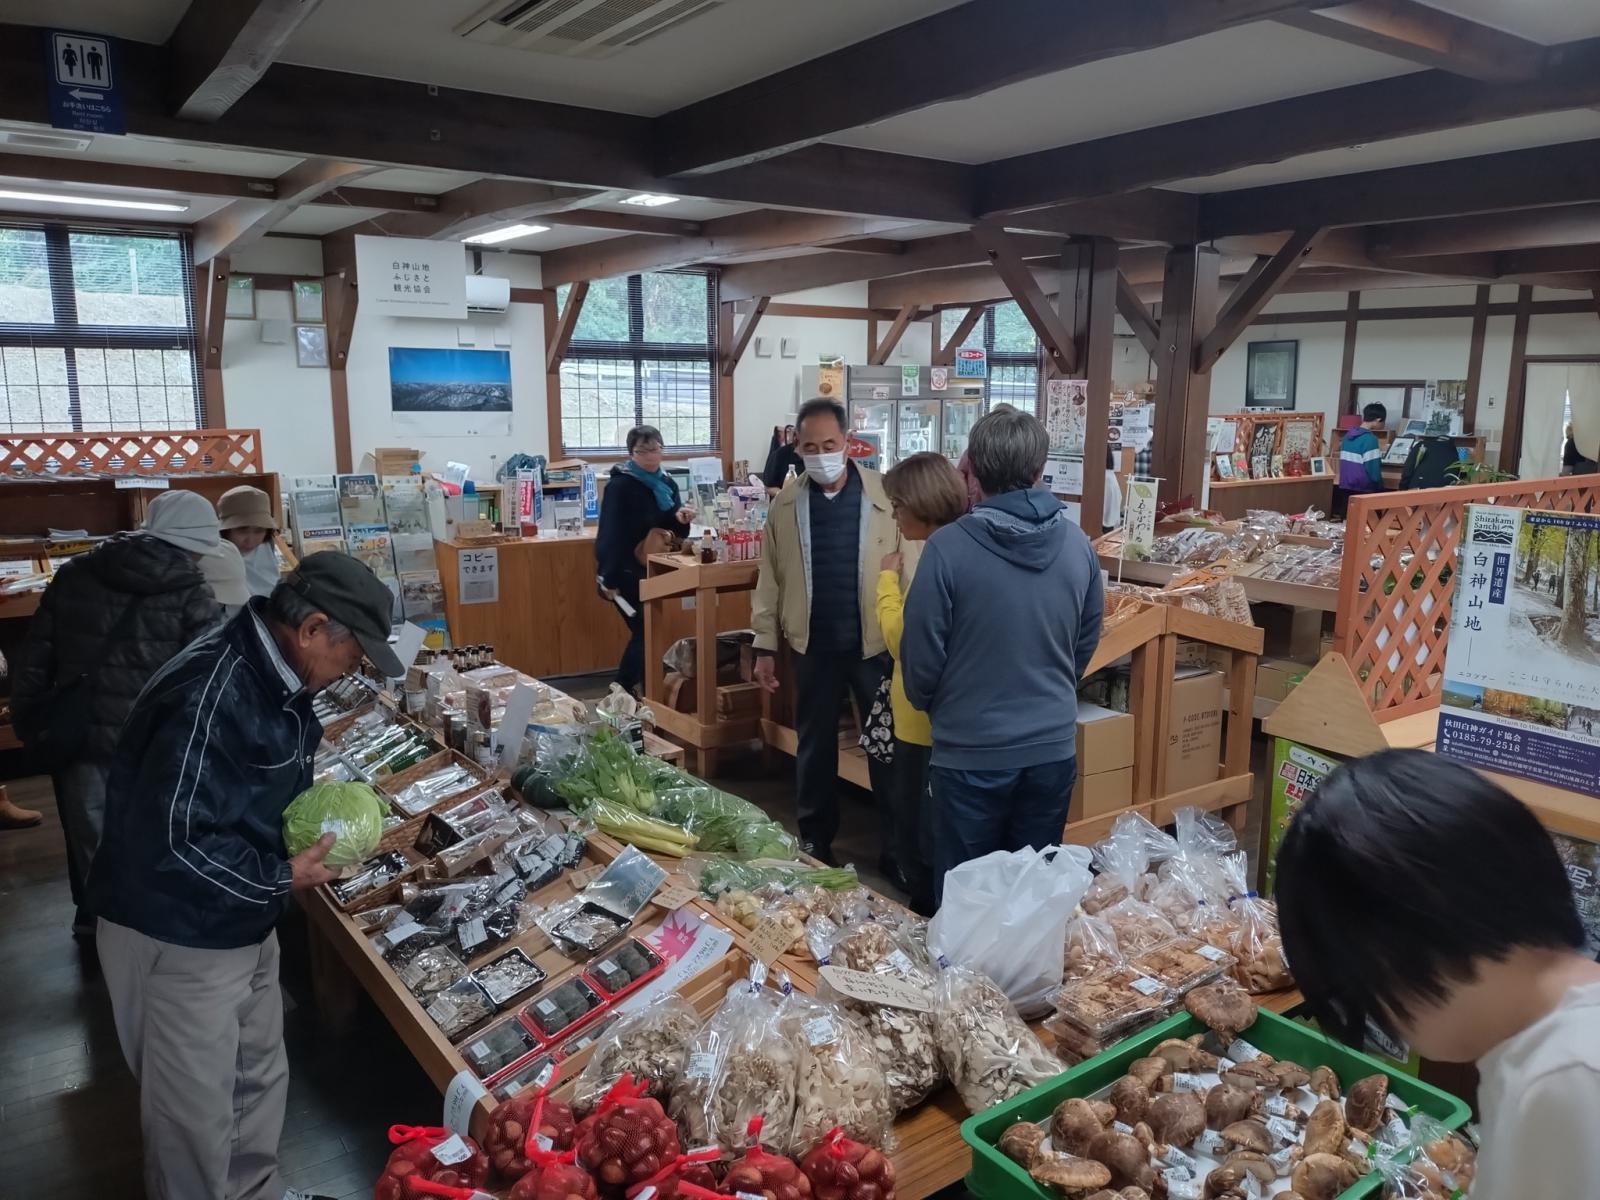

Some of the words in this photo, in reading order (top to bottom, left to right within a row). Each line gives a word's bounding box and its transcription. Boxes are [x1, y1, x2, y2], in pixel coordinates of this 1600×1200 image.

[392, 261, 430, 272] 白神山地
[393, 273, 431, 282] ふじさと
[394, 284, 431, 294] 観光協会
[1474, 515, 1515, 525] Shirakami
[1473, 522, 1500, 531] Sanchi
[463, 553, 495, 562] コピー
[463, 564, 495, 574] できます
[1491, 556, 1507, 599] 世界遺産
[1463, 551, 1489, 631] 白神山地
[1457, 671, 1496, 681] エコツアー
[1496, 717, 1520, 727] Return
[1529, 724, 1541, 733] the
[1445, 719, 1522, 742] 秋田白神ガイド協会
[1452, 731, 1520, 752] 0185-79-2518
